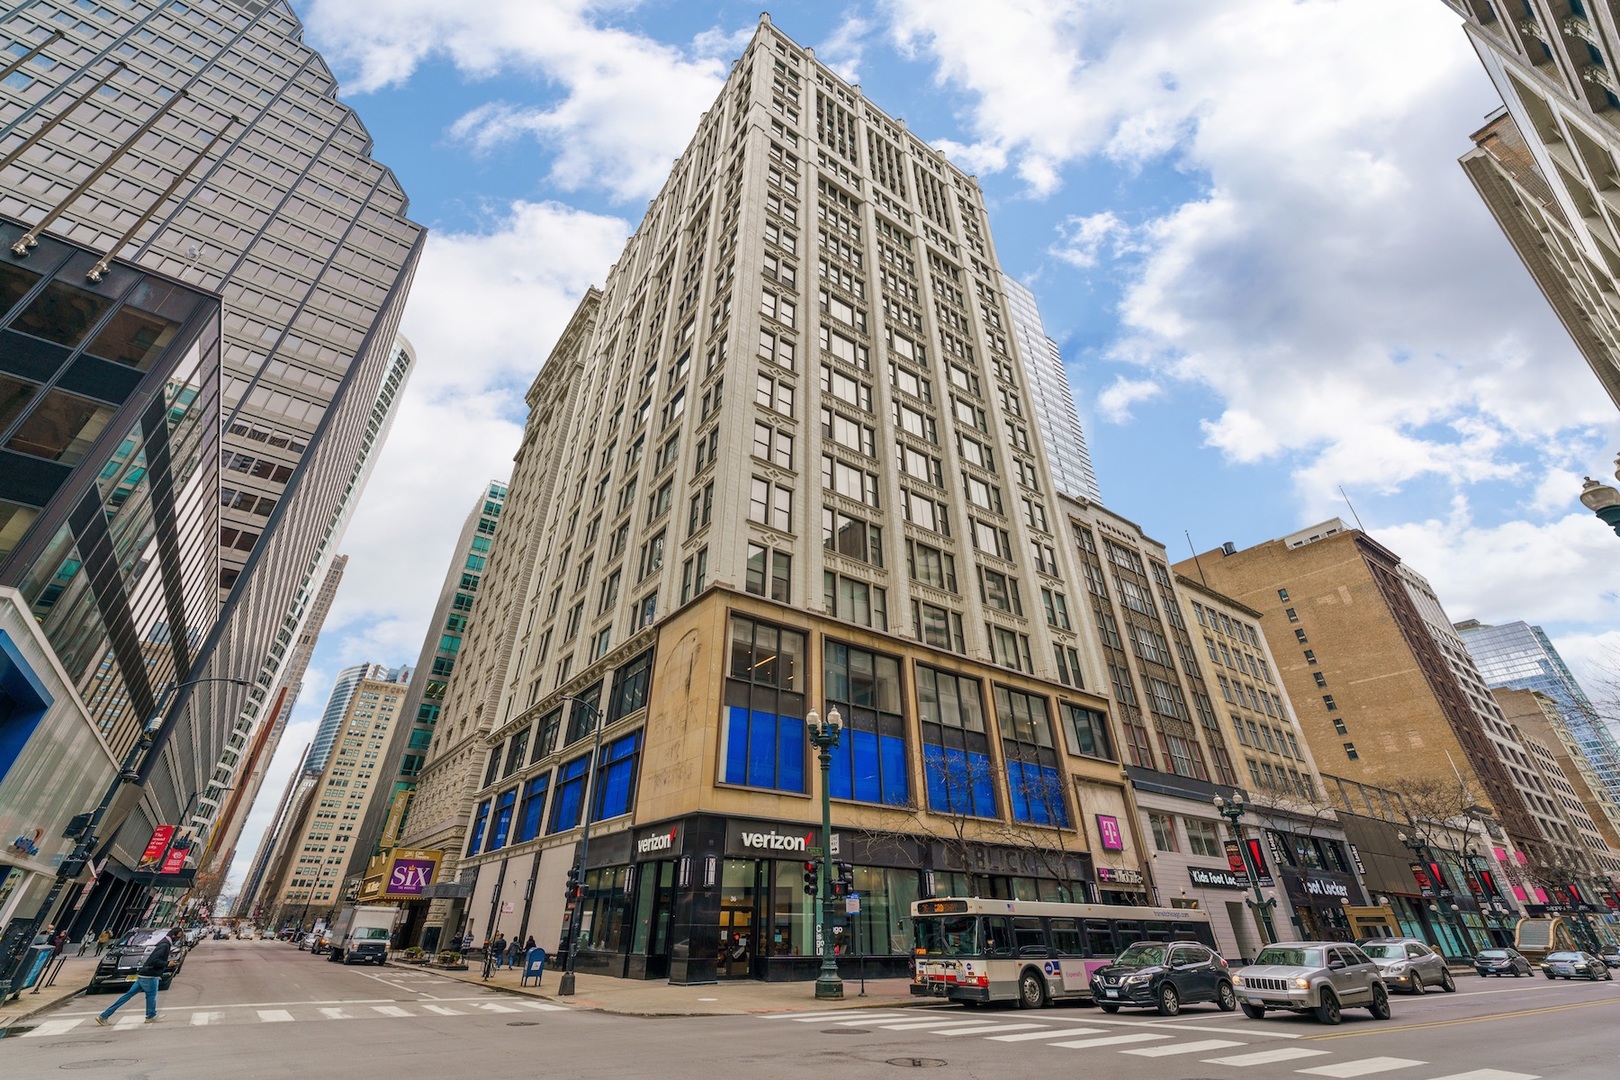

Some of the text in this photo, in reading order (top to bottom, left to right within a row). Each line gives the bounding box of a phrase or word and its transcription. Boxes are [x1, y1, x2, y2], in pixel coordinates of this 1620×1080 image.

[386, 795, 405, 841] Hampton Inn
[637, 832, 672, 853] verizon
[741, 830, 806, 852] verizon
[1102, 820, 1117, 844] T
[1266, 831, 1282, 864] Foot Locker
[1192, 870, 1209, 883] Kids
[1208, 872, 1226, 884] Foot
[1320, 880, 1348, 896] Locker
